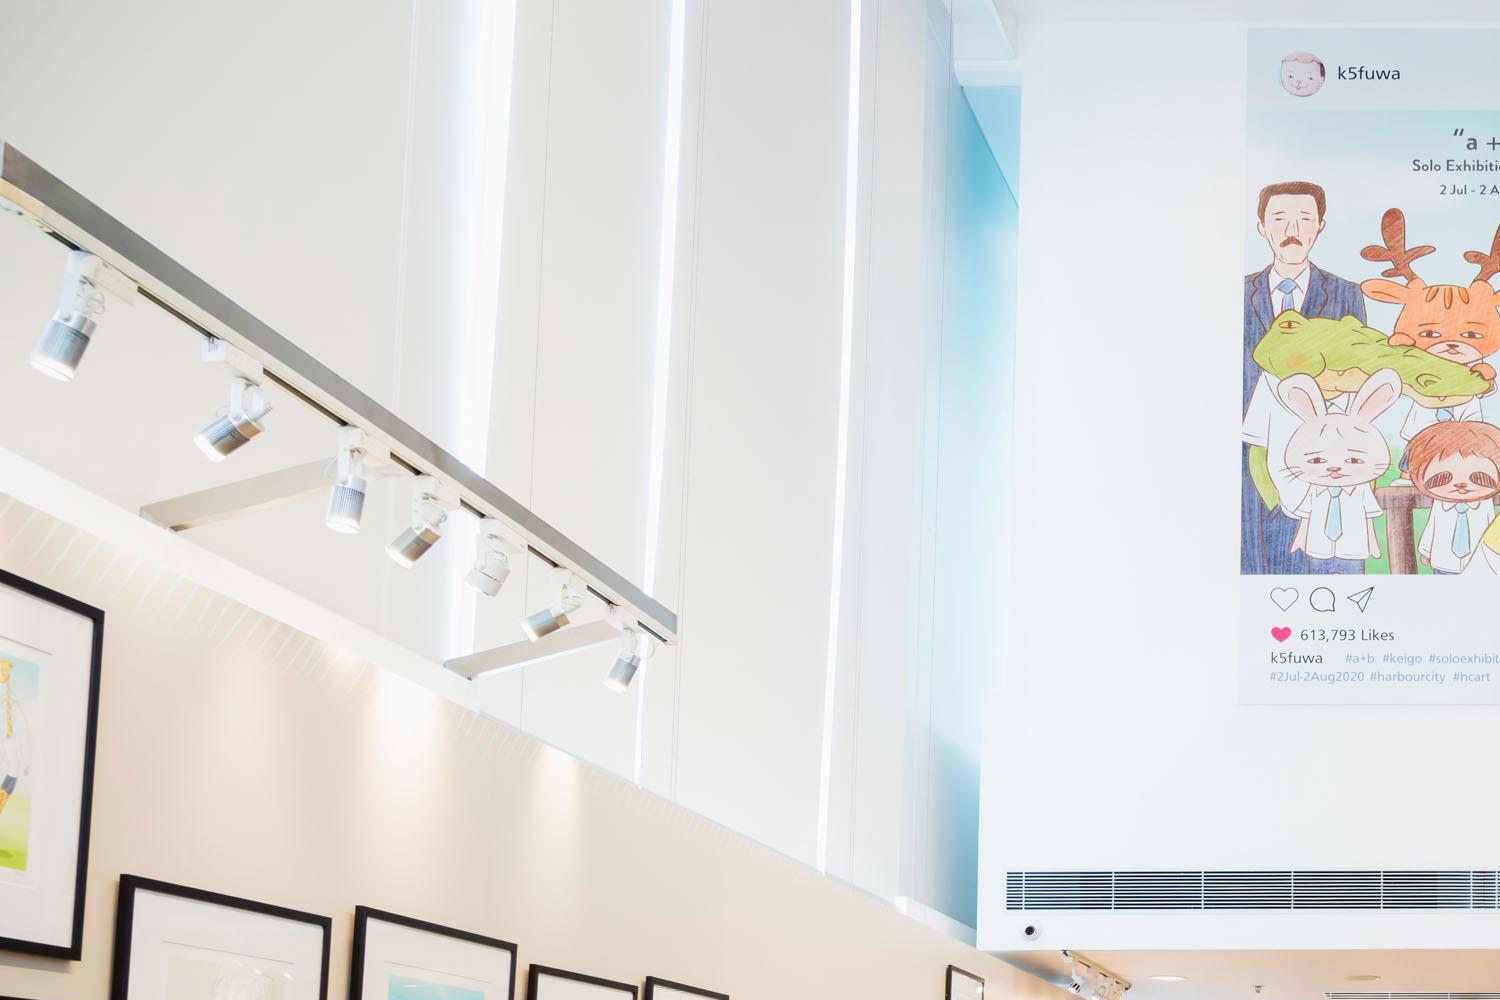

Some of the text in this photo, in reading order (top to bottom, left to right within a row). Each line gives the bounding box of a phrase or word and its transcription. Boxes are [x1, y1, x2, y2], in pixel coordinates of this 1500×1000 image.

[1337, 65, 1401, 81] k5fuwa
[1412, 159, 1442, 172] Solo
[1439, 184, 1447, 196] 2
[1449, 184, 1467, 196] Jul
[1479, 184, 1487, 196] 2
[1300, 628, 1395, 643] 613,793 Likes
[1271, 651, 1323, 664] k5fuwa
[1345, 652, 1375, 664] #a+b
[1382, 652, 1423, 667] #keigo
[1269, 671, 1491, 685] #2Jul-2Aug2020 #harbourcity #hcart
